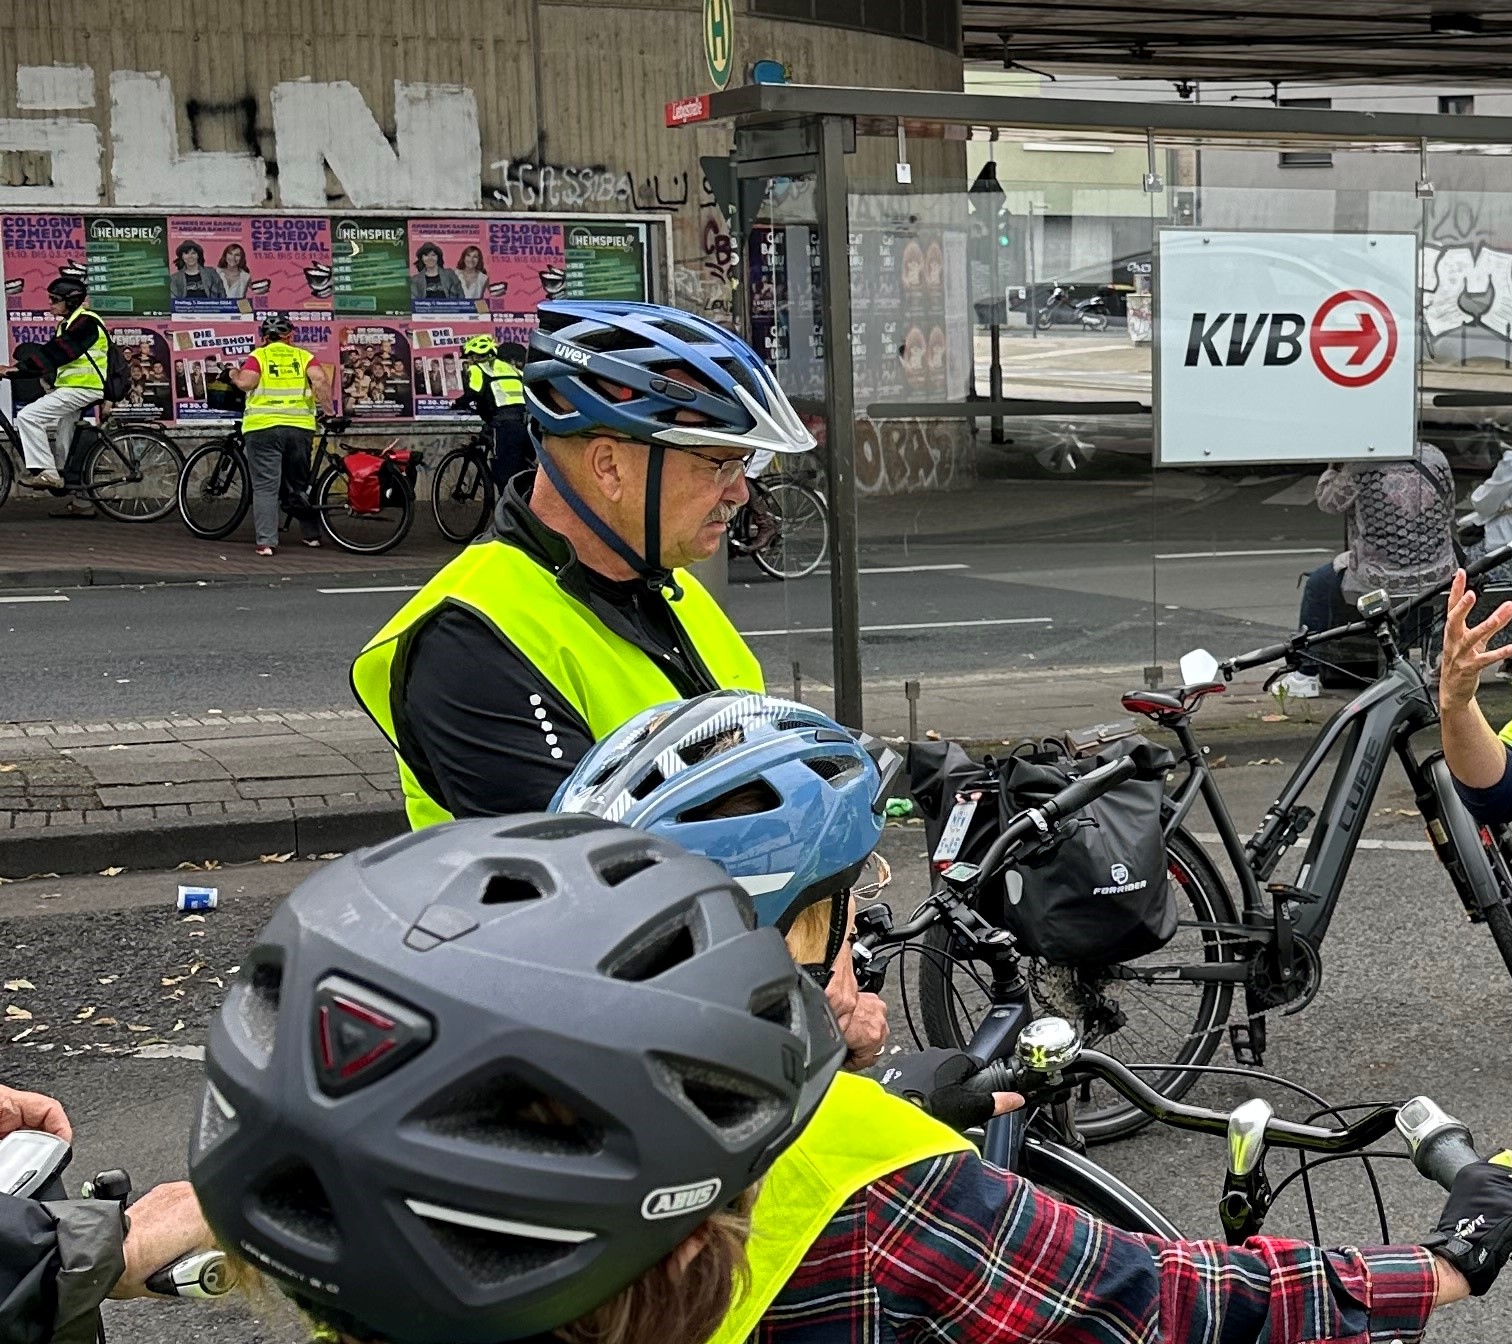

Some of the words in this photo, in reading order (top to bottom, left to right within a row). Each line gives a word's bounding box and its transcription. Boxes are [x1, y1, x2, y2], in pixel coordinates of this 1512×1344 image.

[3, 217, 82, 228] COLOGNE
[251, 219, 326, 231] COLOGNE
[3, 228, 73, 239] COMEDY
[98, 227, 154, 239] HEIMSPIEL
[343, 228, 397, 241] HEIMSPIEL
[489, 224, 561, 235] COLOGNE
[251, 230, 318, 241] COMEDY
[489, 235, 552, 246] COMEDY
[576, 235, 627, 247] HEIMSPIEL
[5, 239, 85, 250] FESTIVAL
[252, 241, 330, 252] FESTIVAL
[490, 245, 564, 256] FESTIVAL
[193, 330, 212, 338] DIE
[1184, 312, 1306, 367] KVB
[111, 334, 155, 346] VENGERS
[194, 336, 254, 347] LESESHOW
[225, 346, 250, 355] LIVE
[554, 343, 592, 367] uvex
[1338, 737, 1381, 833] CUBE
[652, 1185, 714, 1214] ABUS
